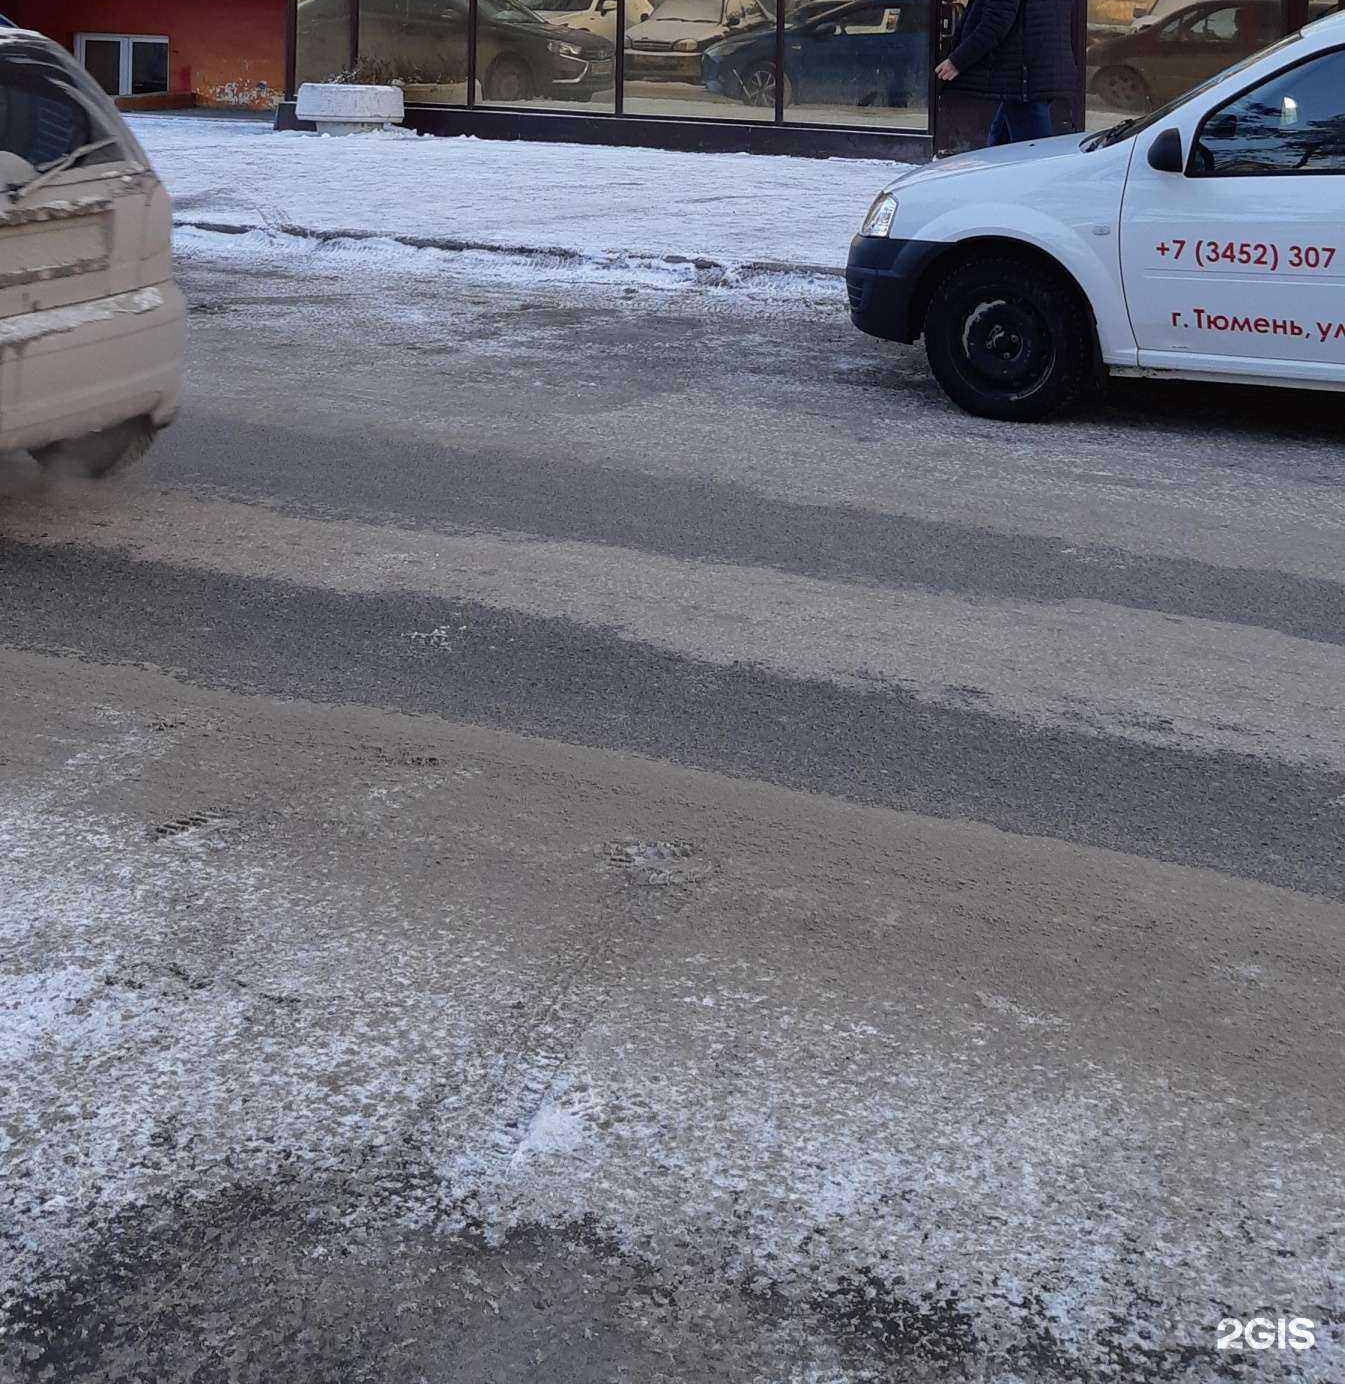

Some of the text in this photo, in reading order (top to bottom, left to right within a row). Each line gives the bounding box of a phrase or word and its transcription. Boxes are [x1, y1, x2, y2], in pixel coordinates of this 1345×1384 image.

[1155, 239, 1336, 271] +7 (3452) 307
[1193, 308, 1311, 339] Тюмень,
